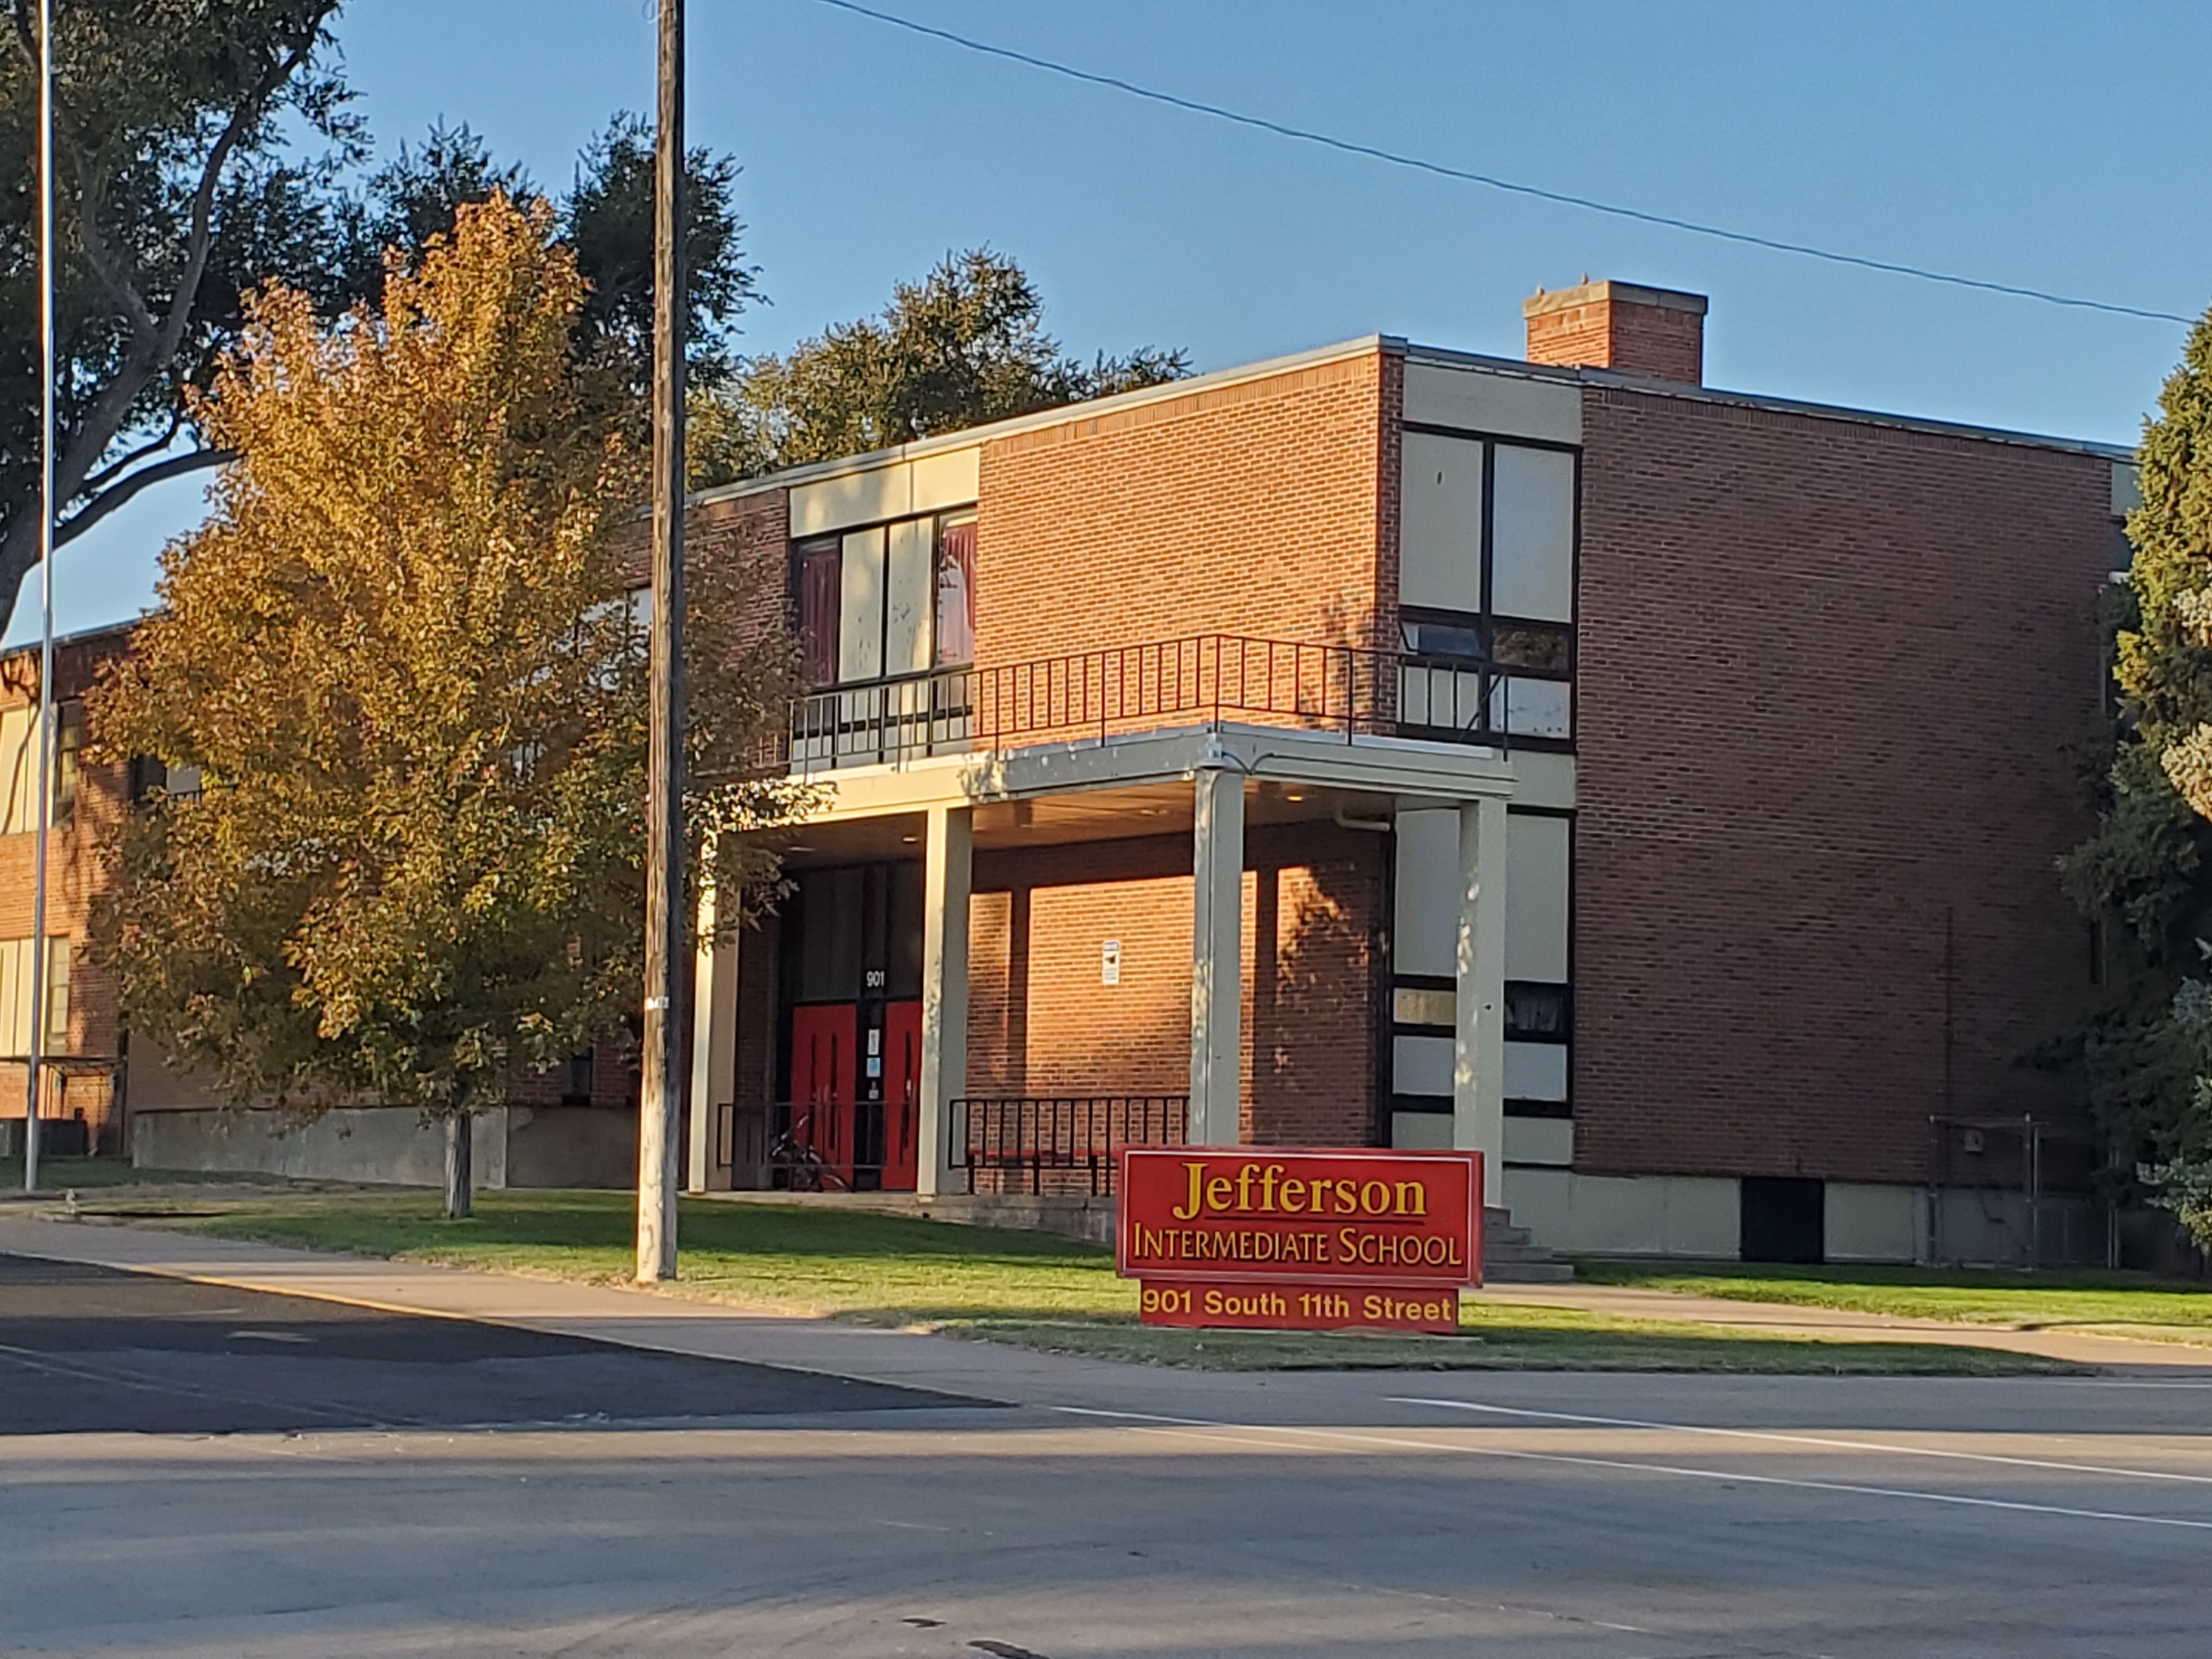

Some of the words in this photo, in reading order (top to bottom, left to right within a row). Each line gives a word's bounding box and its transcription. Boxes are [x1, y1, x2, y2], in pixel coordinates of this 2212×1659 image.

[867, 970, 884, 987] 901
[1172, 1162, 1426, 1220] Jefferson
[1134, 1222, 1328, 1261] INTERMEDIATE
[1339, 1228, 1462, 1265] SCHOOL
[1143, 1289, 1191, 1313] 901
[1204, 1291, 1286, 1316] South
[1298, 1294, 1350, 1317] 11th
[1363, 1296, 1451, 1321] Street
